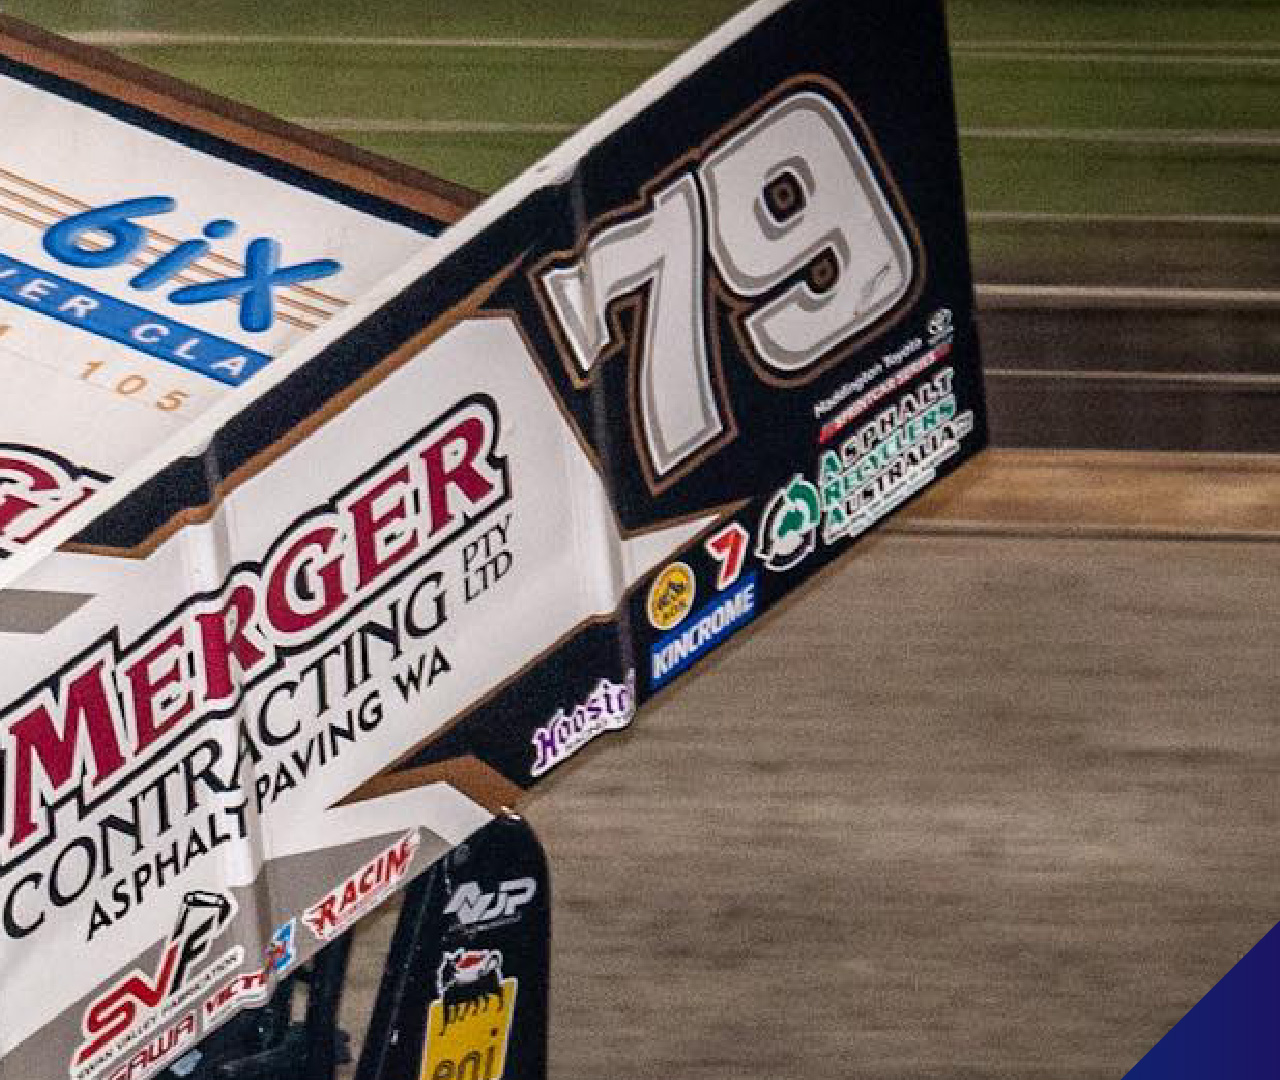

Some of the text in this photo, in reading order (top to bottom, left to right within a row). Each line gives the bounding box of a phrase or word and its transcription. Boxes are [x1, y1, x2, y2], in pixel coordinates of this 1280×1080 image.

[538, 88, 917, 480] 79
[79, 359, 191, 414] 105
[823, 369, 954, 477] ASPHALT
[824, 397, 956, 507] RECYCLERS
[830, 424, 955, 525] AUSTRALIA
[461, 548, 514, 604] LTD
[652, 583, 755, 679] KINCROME
[1, 570, 446, 942] CONTRACTING
[460, 514, 514, 574] PTY
[87, 800, 251, 943] ASPHALT
[256, 695, 386, 815] PAVING
[391, 644, 452, 707] WA
